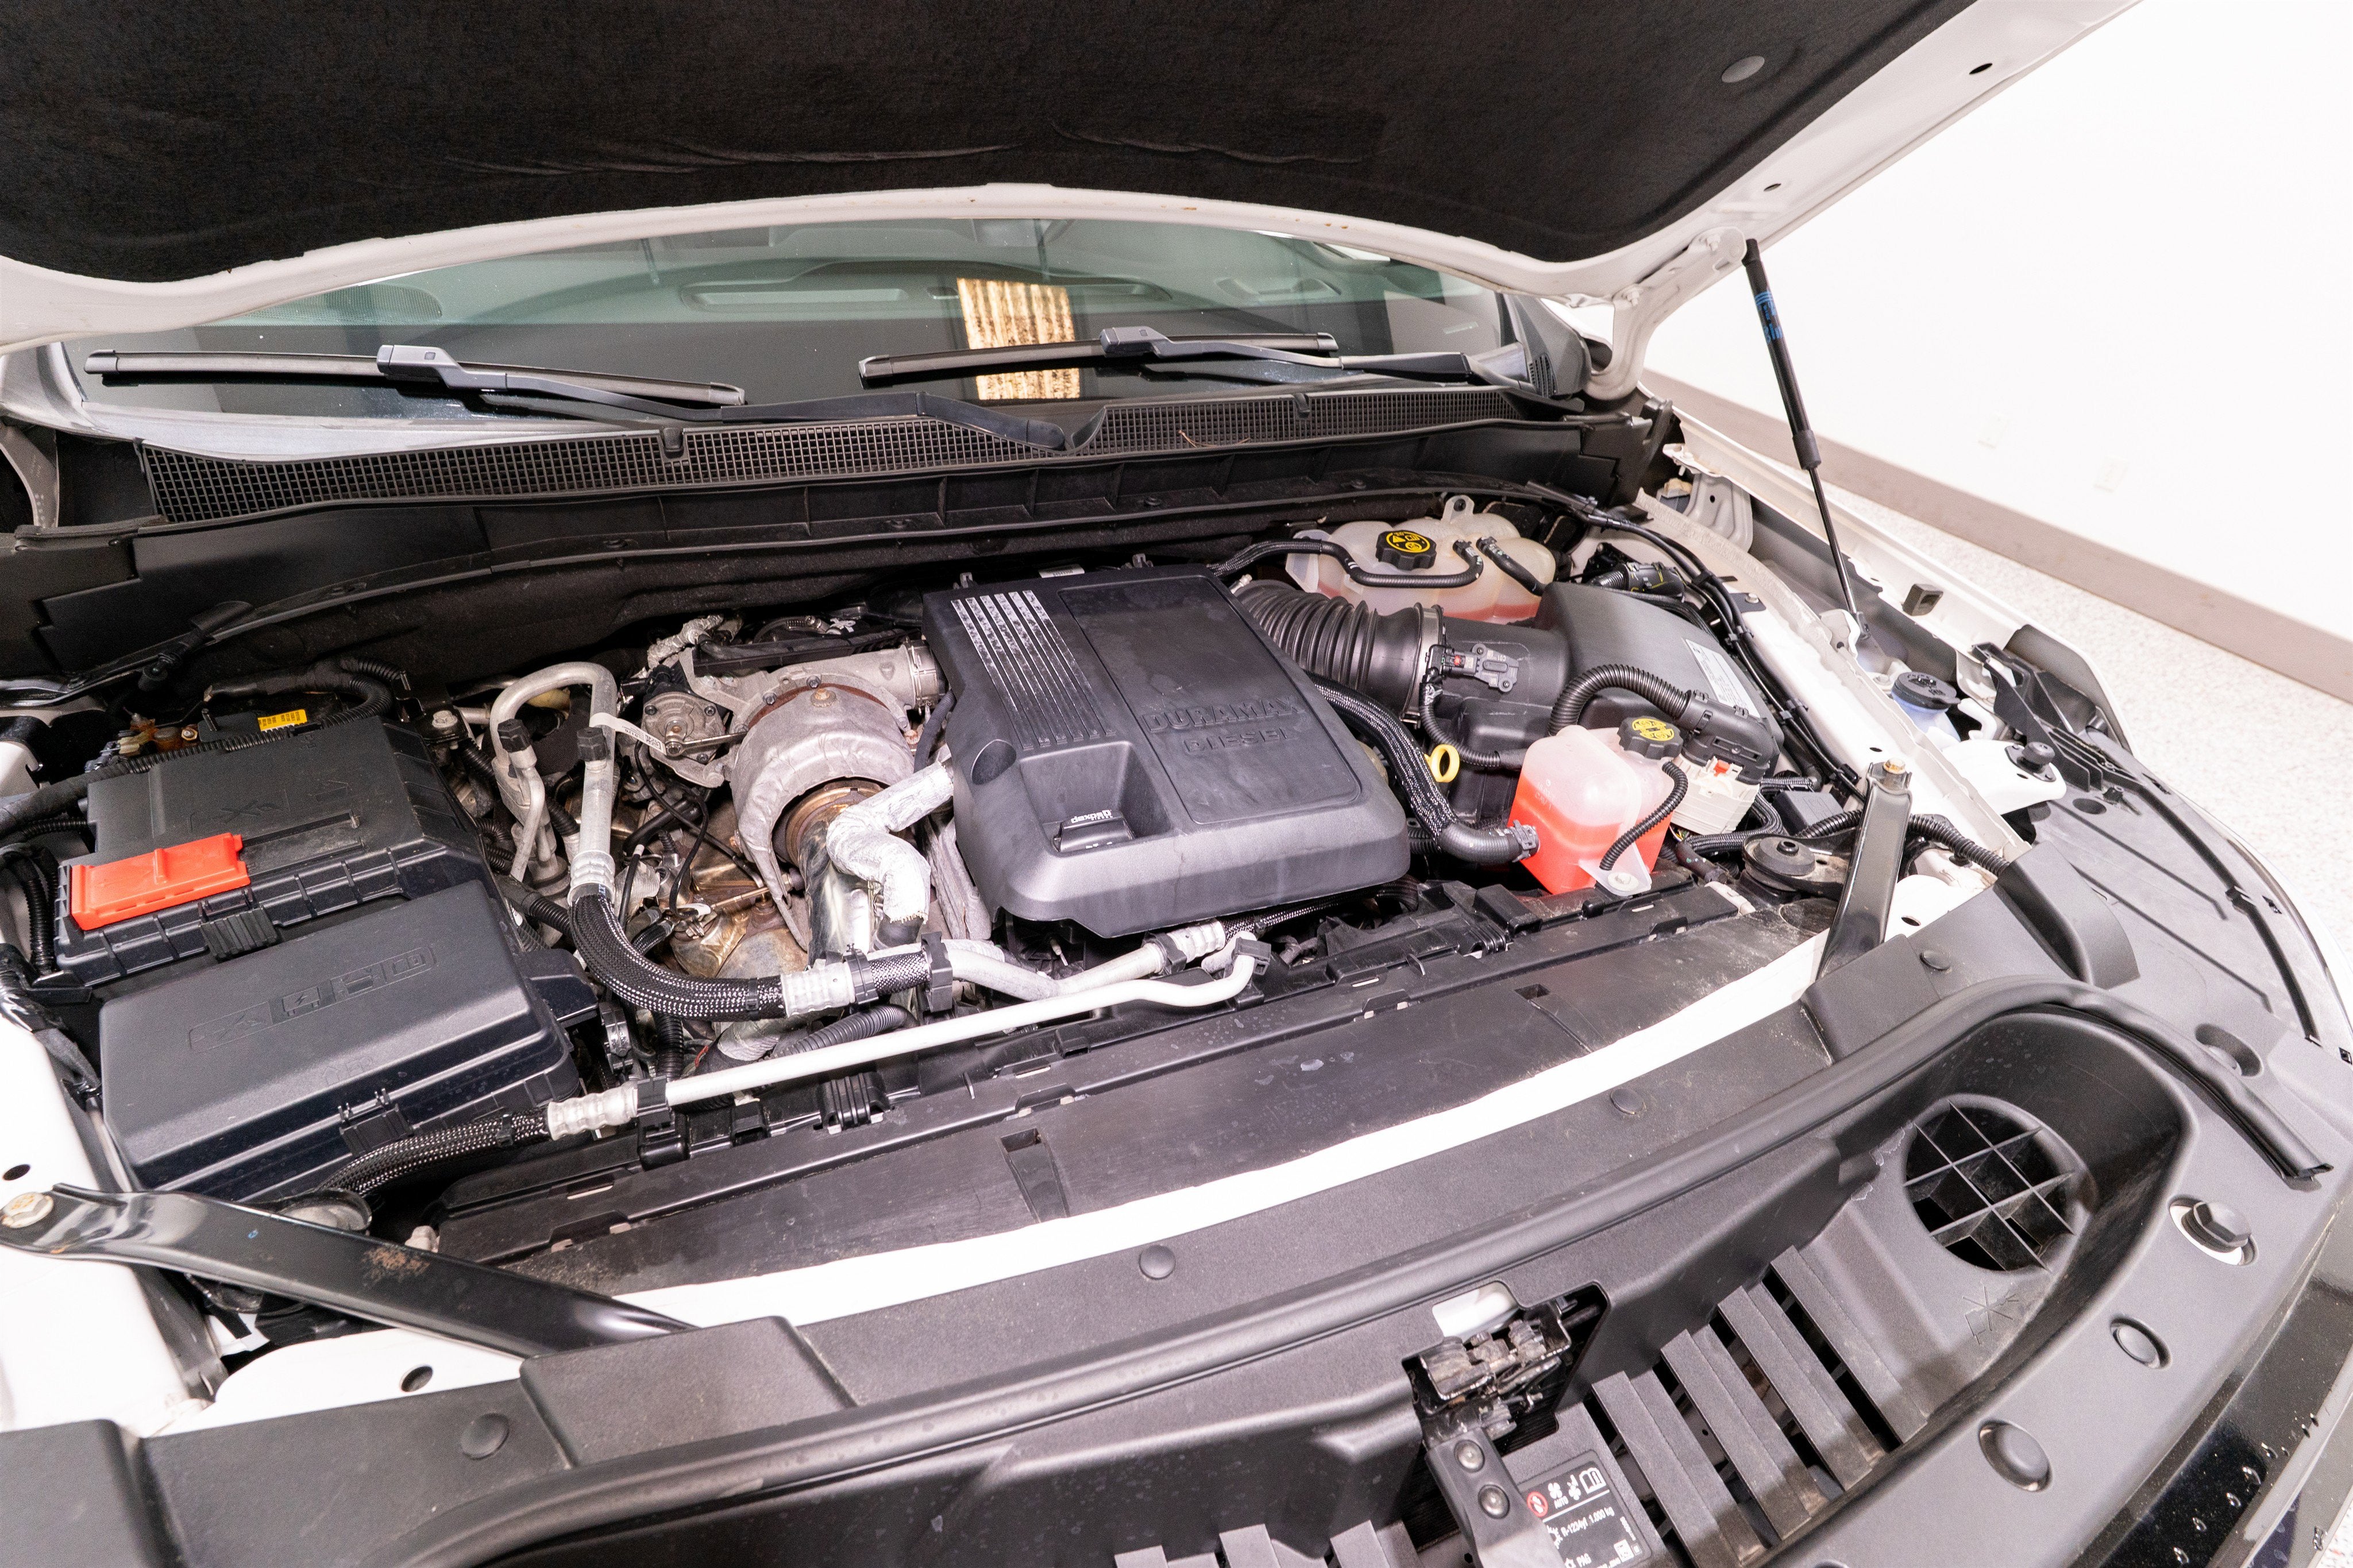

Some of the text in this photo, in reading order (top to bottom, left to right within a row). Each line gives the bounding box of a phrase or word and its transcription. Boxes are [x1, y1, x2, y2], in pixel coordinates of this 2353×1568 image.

[1142, 696, 1305, 733] DURAMAX
[1185, 726, 1297, 754] DIESEL
[1554, 1496, 1569, 1509] AUTO
[1604, 1507, 1615, 1516] kg
[1576, 1553, 1592, 1567] PAG
